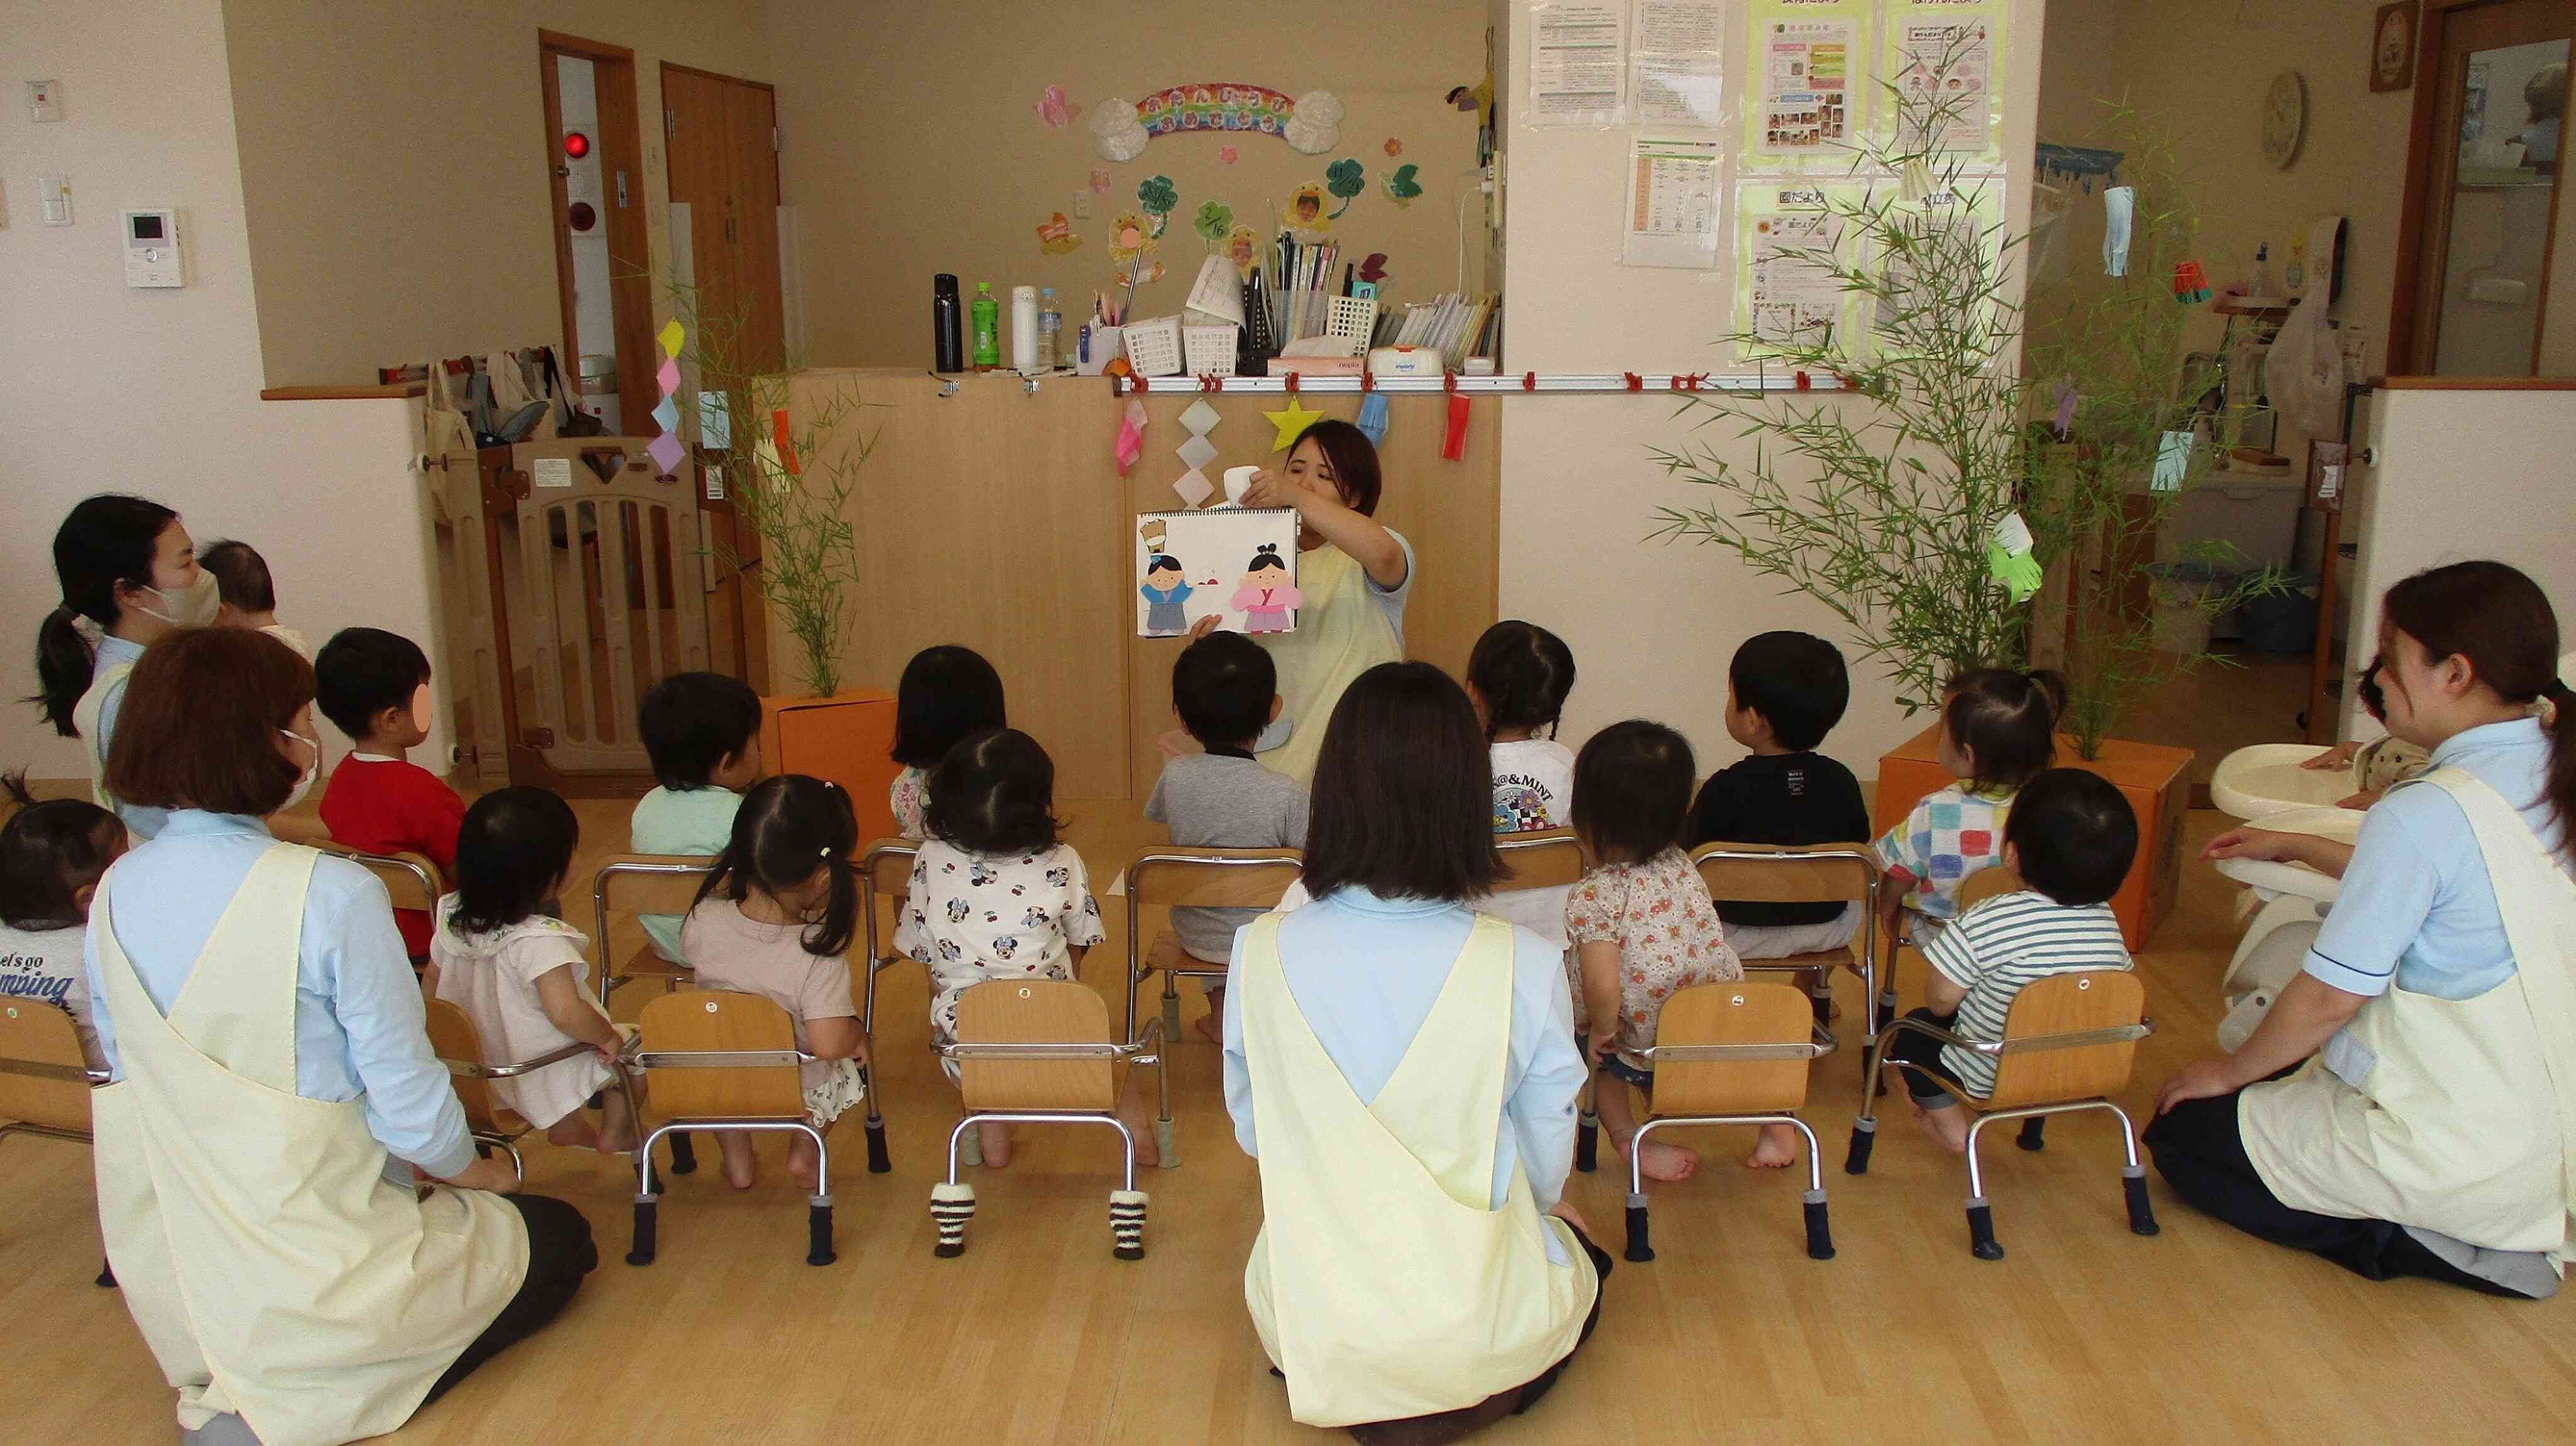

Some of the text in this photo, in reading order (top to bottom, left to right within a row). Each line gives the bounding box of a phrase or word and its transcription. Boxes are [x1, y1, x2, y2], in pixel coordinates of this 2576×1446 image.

[1161, 111, 1275, 131] おめでとう
[1779, 191, 1824, 203] 園だより
[0, 951, 43, 973] et's go
[0, 972, 74, 1007] mping
